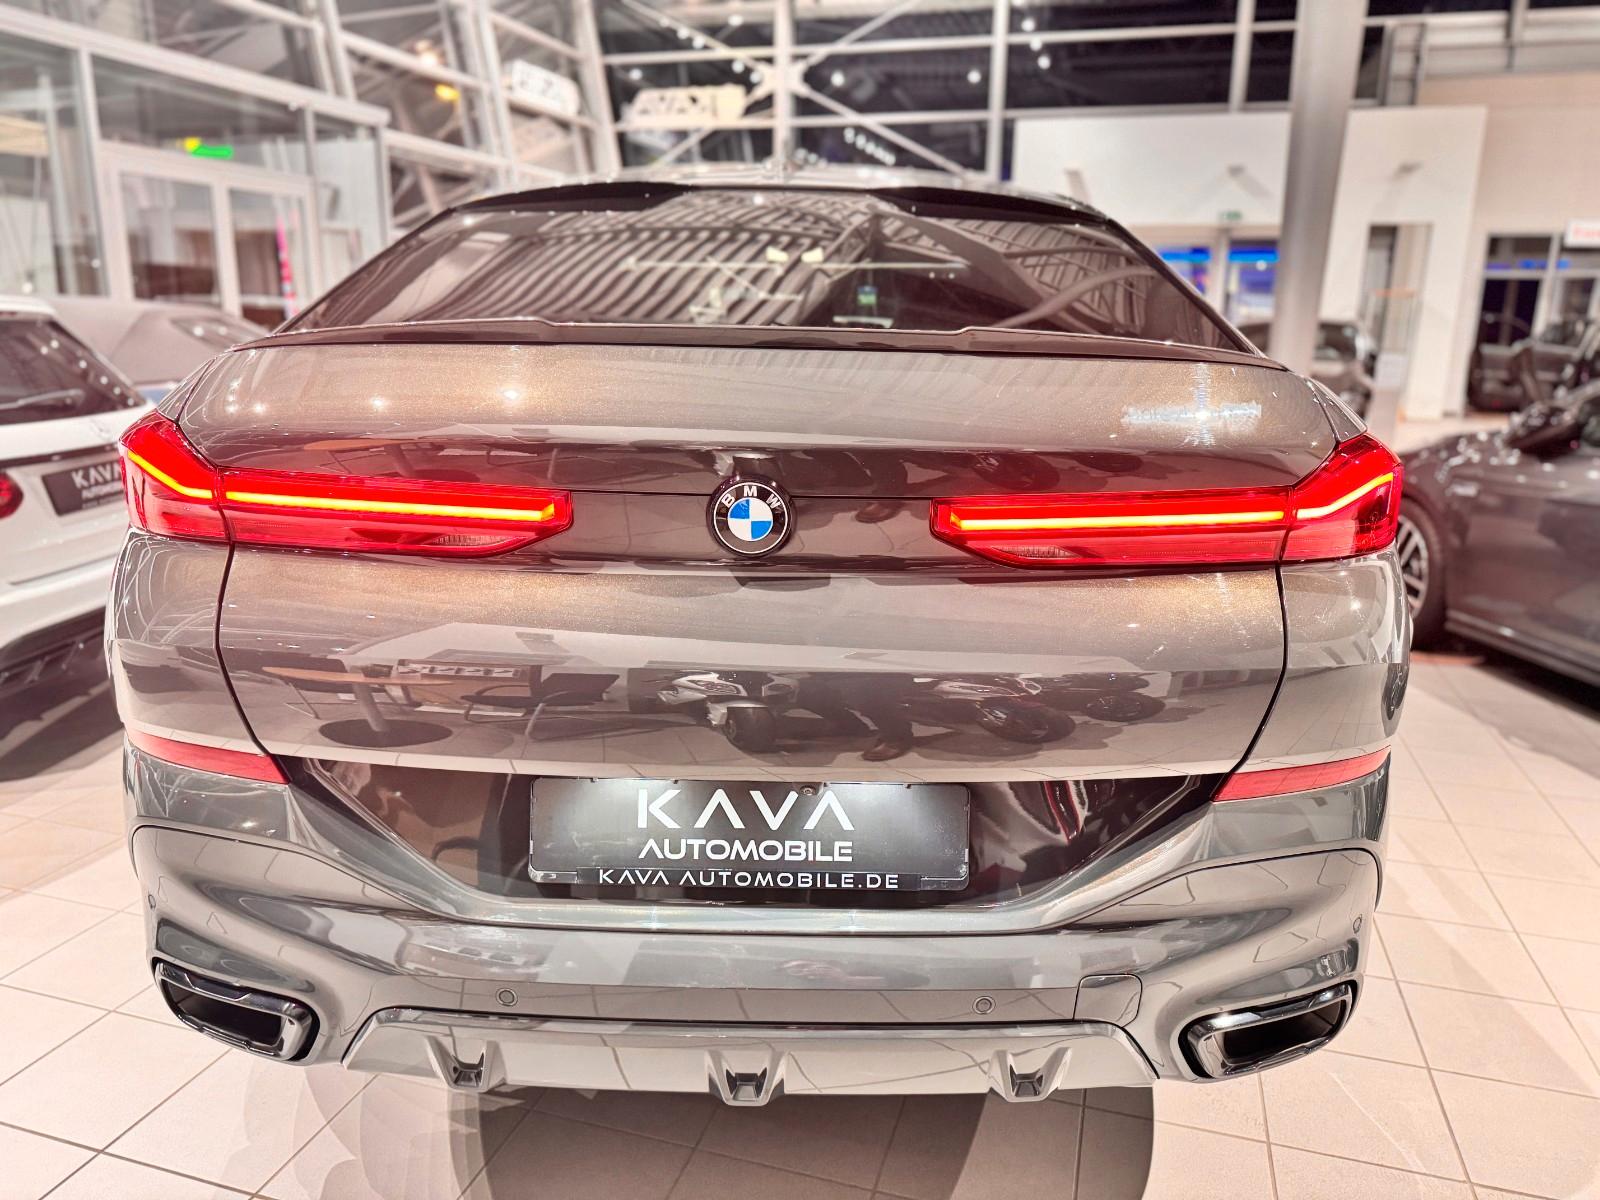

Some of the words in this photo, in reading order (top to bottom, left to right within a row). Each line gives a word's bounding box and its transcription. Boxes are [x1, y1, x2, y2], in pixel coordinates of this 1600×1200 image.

[721, 485, 782, 509] BMW
[637, 788, 855, 830] KAVA
[638, 838, 853, 862] AUTOMOBILE
[599, 869, 670, 885] KAVA
[679, 870, 899, 889] AUTOMOBILE.DE
